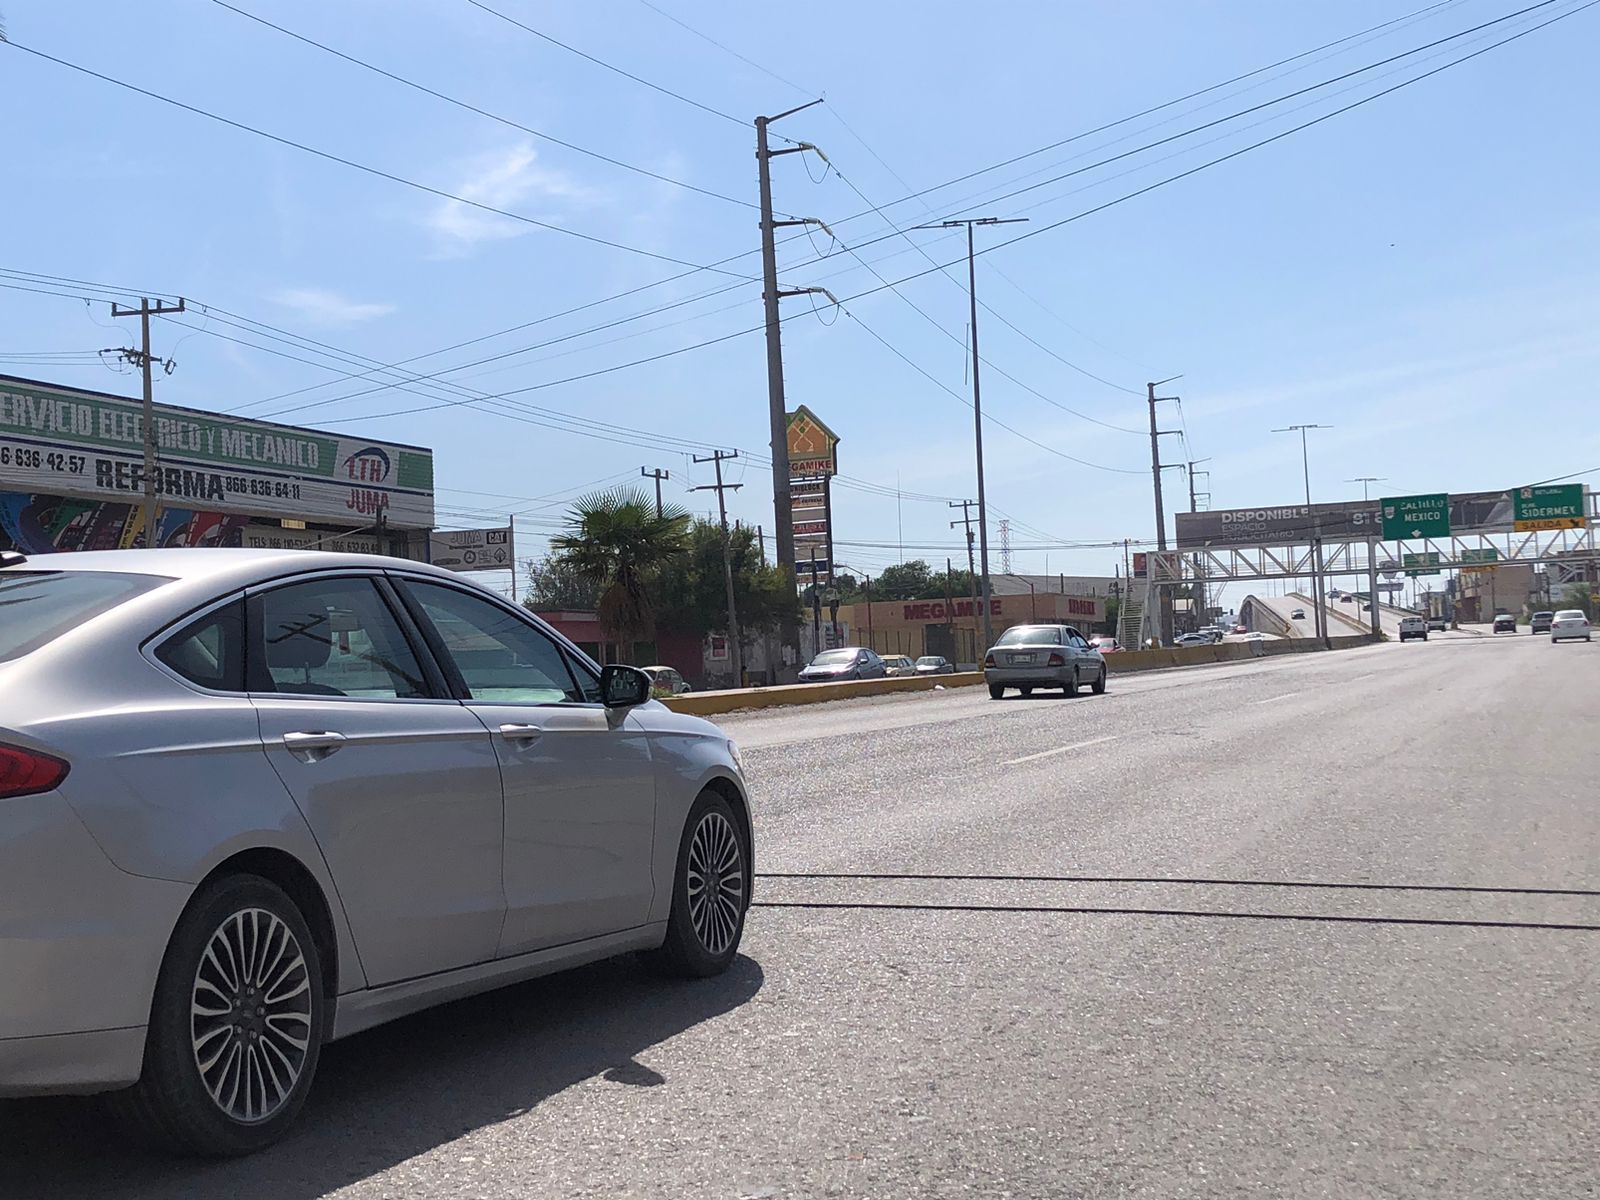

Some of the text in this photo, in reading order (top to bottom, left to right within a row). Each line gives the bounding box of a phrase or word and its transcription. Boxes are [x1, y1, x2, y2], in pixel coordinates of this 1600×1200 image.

[99, 407, 202, 452] ELECRICO
[205, 425, 216, 455] Y
[221, 428, 319, 470] MECANICO
[346, 455, 382, 483] LTH
[346, 489, 390, 515] JUMA
[1221, 507, 1309, 523] DISPONIBLE
[1404, 511, 1441, 522] MEXICO
[1522, 520, 1562, 530] SALIDA
[489, 532, 505, 543] CAT
